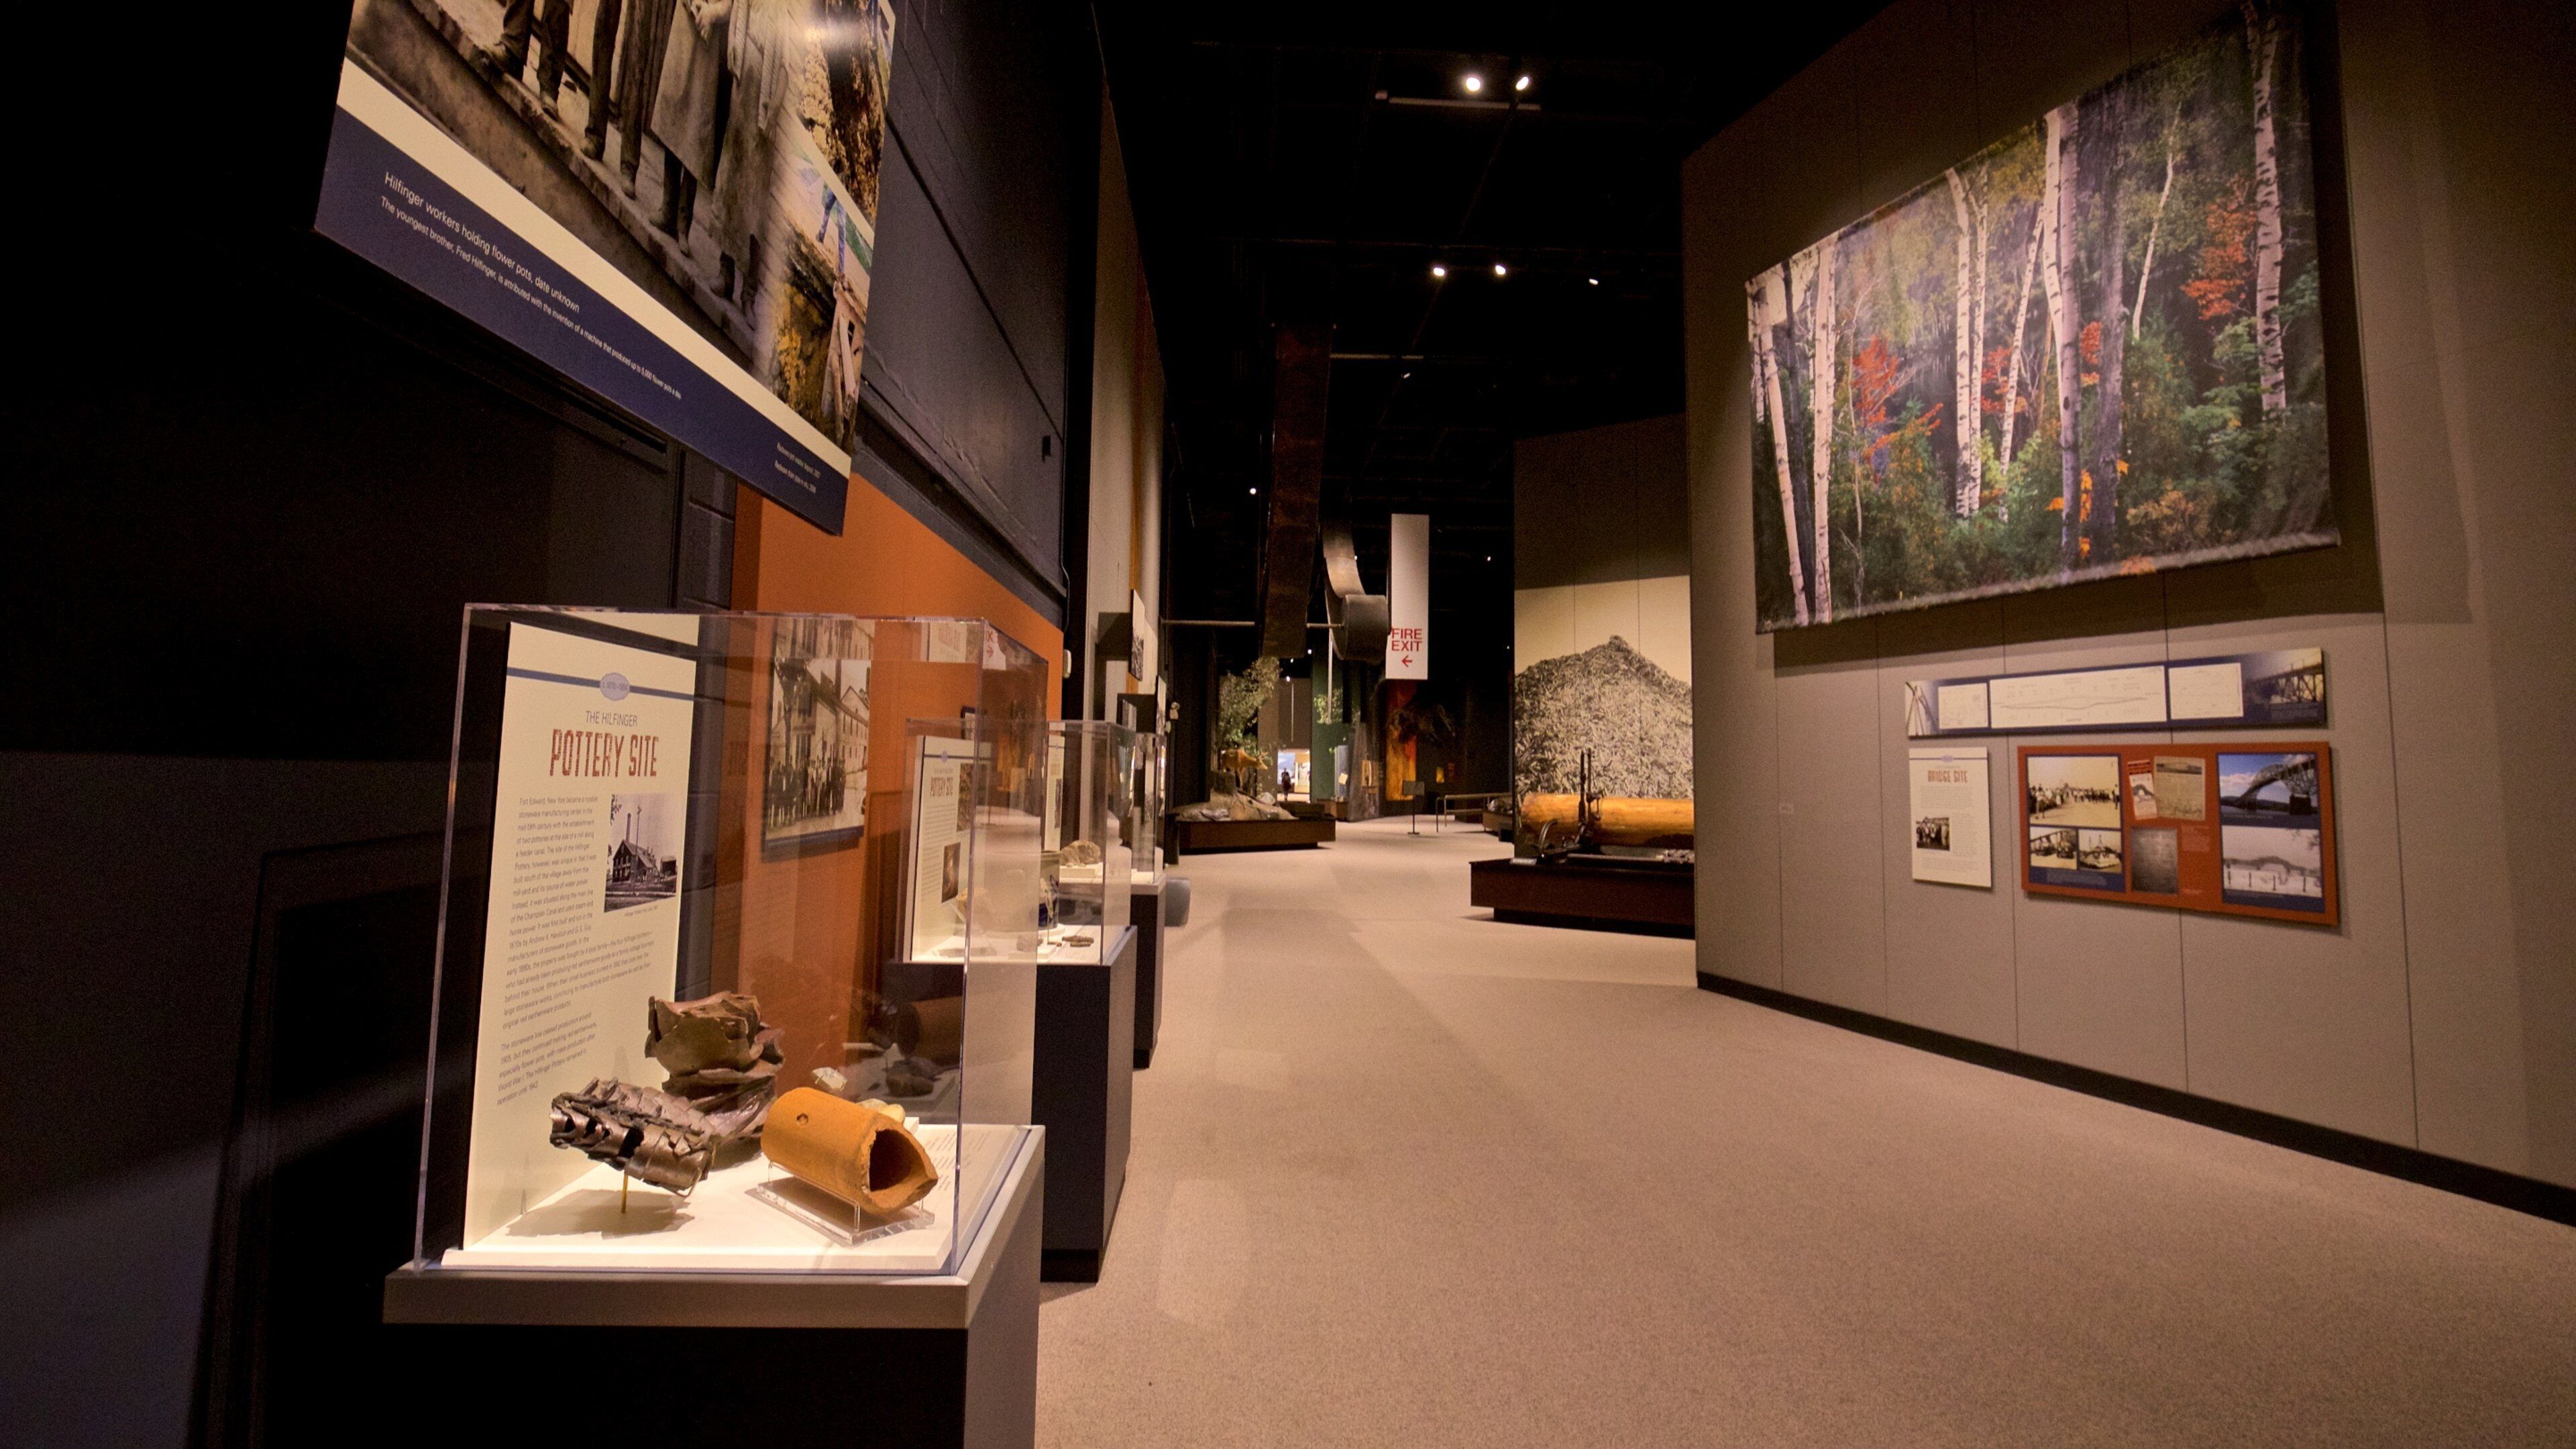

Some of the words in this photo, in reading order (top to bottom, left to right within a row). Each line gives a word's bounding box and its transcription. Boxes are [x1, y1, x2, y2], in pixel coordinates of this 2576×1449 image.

[385, 172, 423, 207] Hilfinger
[427, 203, 460, 232] workers
[462, 225, 490, 255] holding
[492, 246, 515, 268] flower
[516, 264, 533, 283] pots,
[535, 276, 549, 292] date
[551, 288, 579, 312] unknown
[382, 196, 394, 213] The
[397, 209, 429, 235] youngest
[430, 229, 453, 252] brother,
[456, 246, 471, 262] Fred
[472, 256, 496, 280] Hilfinger,
[504, 279, 530, 301] attributed
[531, 297, 542, 308] with
[543, 304, 551, 315] the
[553, 311, 574, 329] invention
[584, 331, 602, 347] machine
[604, 343, 612, 354] that
[612, 350, 631, 366] produced
[1391, 628, 1422, 640] FIRE
[1391, 640, 1422, 652] EXIT
[586, 710, 600, 724] THE
[601, 712, 637, 727] HILFINGER
[549, 729, 625, 777] POTTERY
[629, 734, 659, 777] SITE
[1927, 770, 1951, 783] BRIDGE
[1953, 770, 1968, 783] SITE
